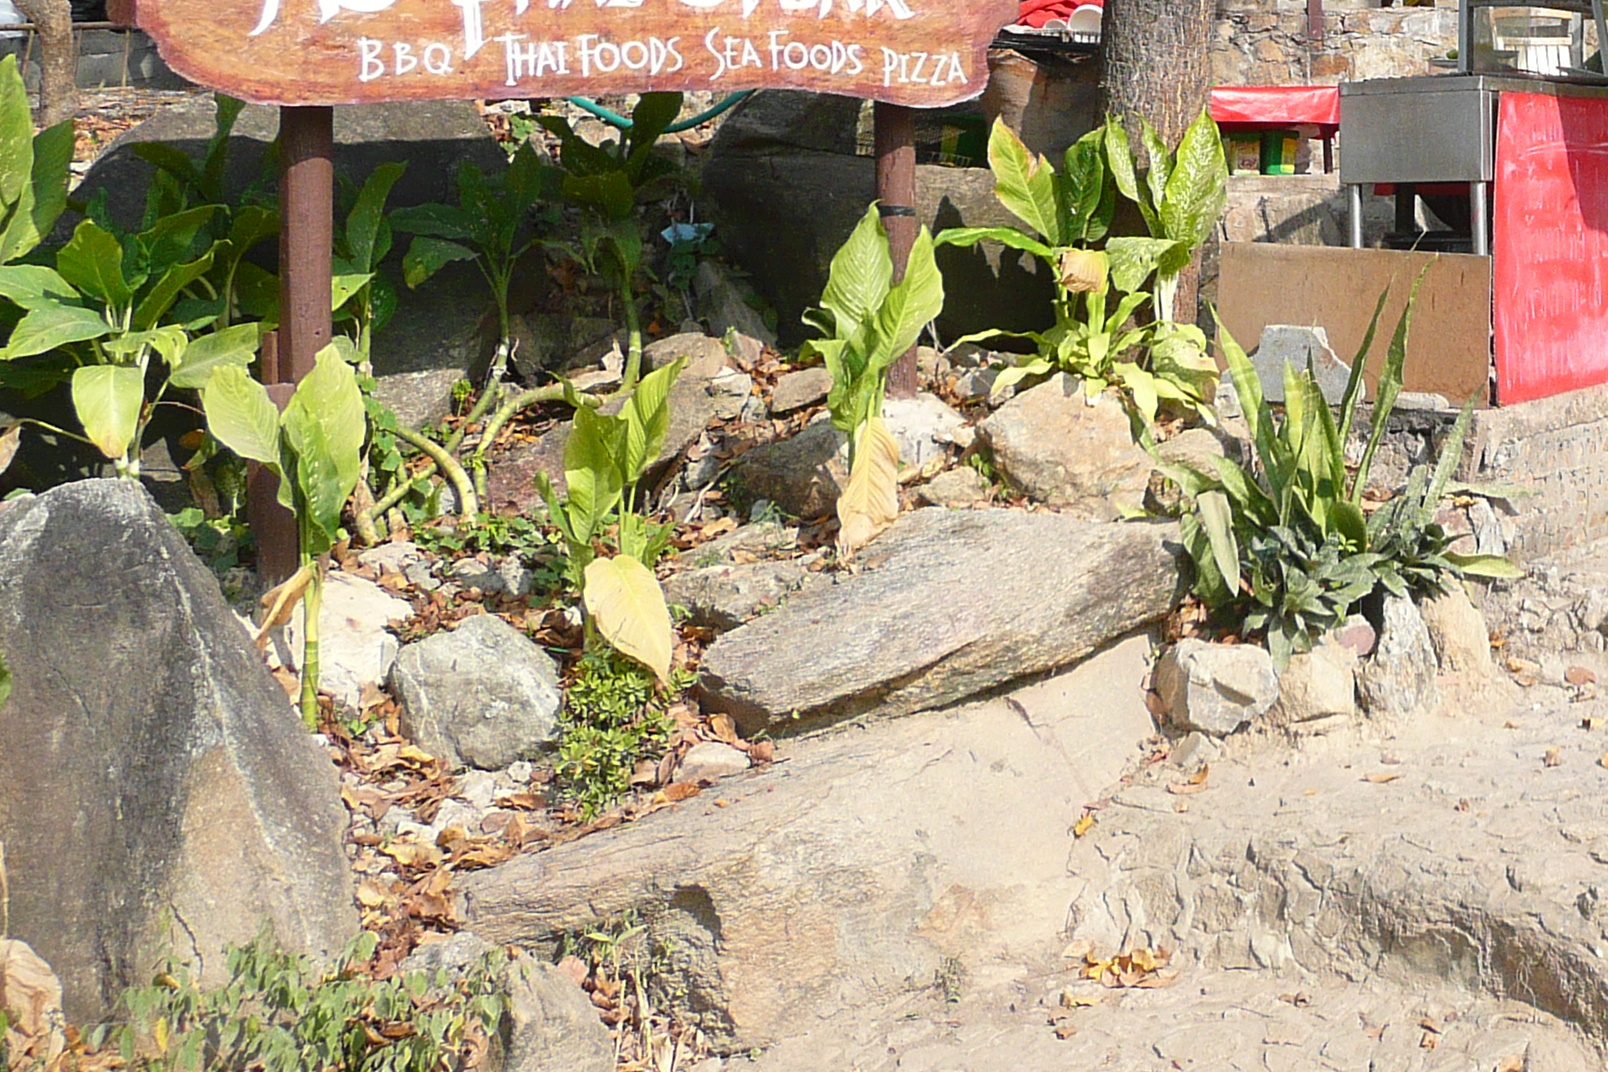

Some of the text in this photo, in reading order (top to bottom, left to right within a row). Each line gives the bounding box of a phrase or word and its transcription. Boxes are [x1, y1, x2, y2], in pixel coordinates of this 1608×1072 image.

[358, 35, 454, 83] BBQ
[493, 32, 570, 86] THAI
[577, 33, 683, 77] FOODS
[882, 45, 968, 87] PIZZA
